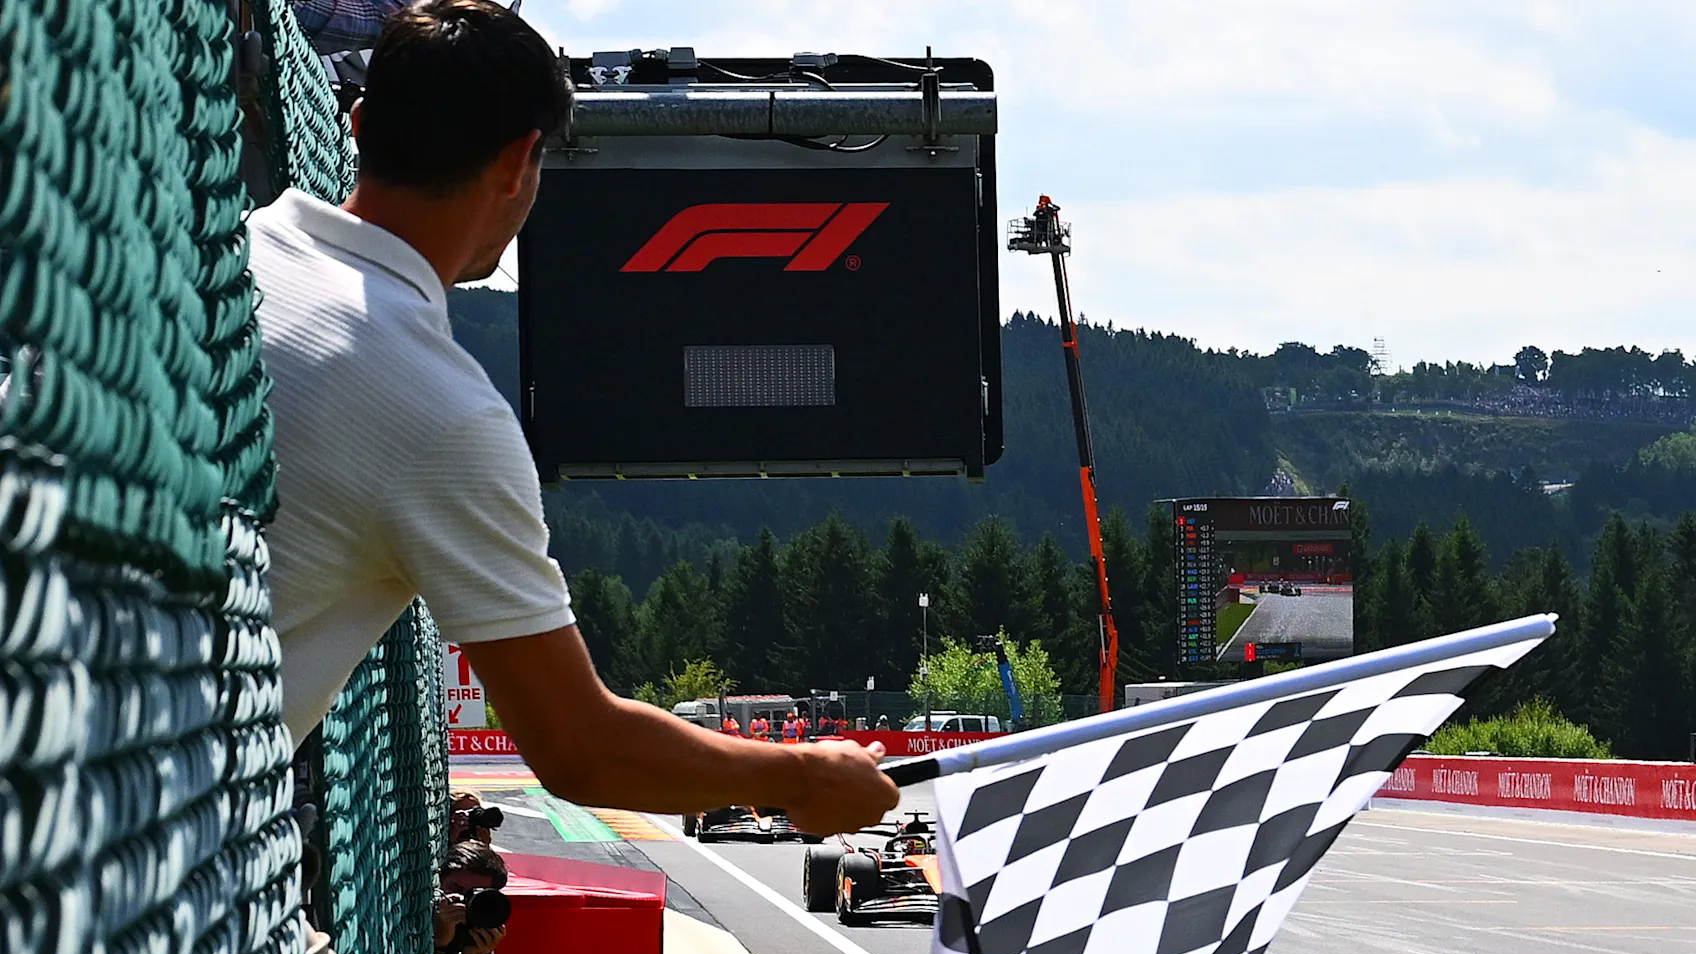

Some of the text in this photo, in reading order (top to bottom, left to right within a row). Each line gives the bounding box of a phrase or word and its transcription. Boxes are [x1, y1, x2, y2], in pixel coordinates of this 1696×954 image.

[1295, 505, 1307, 524] &
[447, 688, 481, 701] FIRE
[447, 732, 468, 751] ËT
[470, 736, 482, 751] &
[907, 736, 937, 753] MOËT
[1600, 776, 1636, 806] CHANDON
[1661, 773, 1685, 810] MOËT
